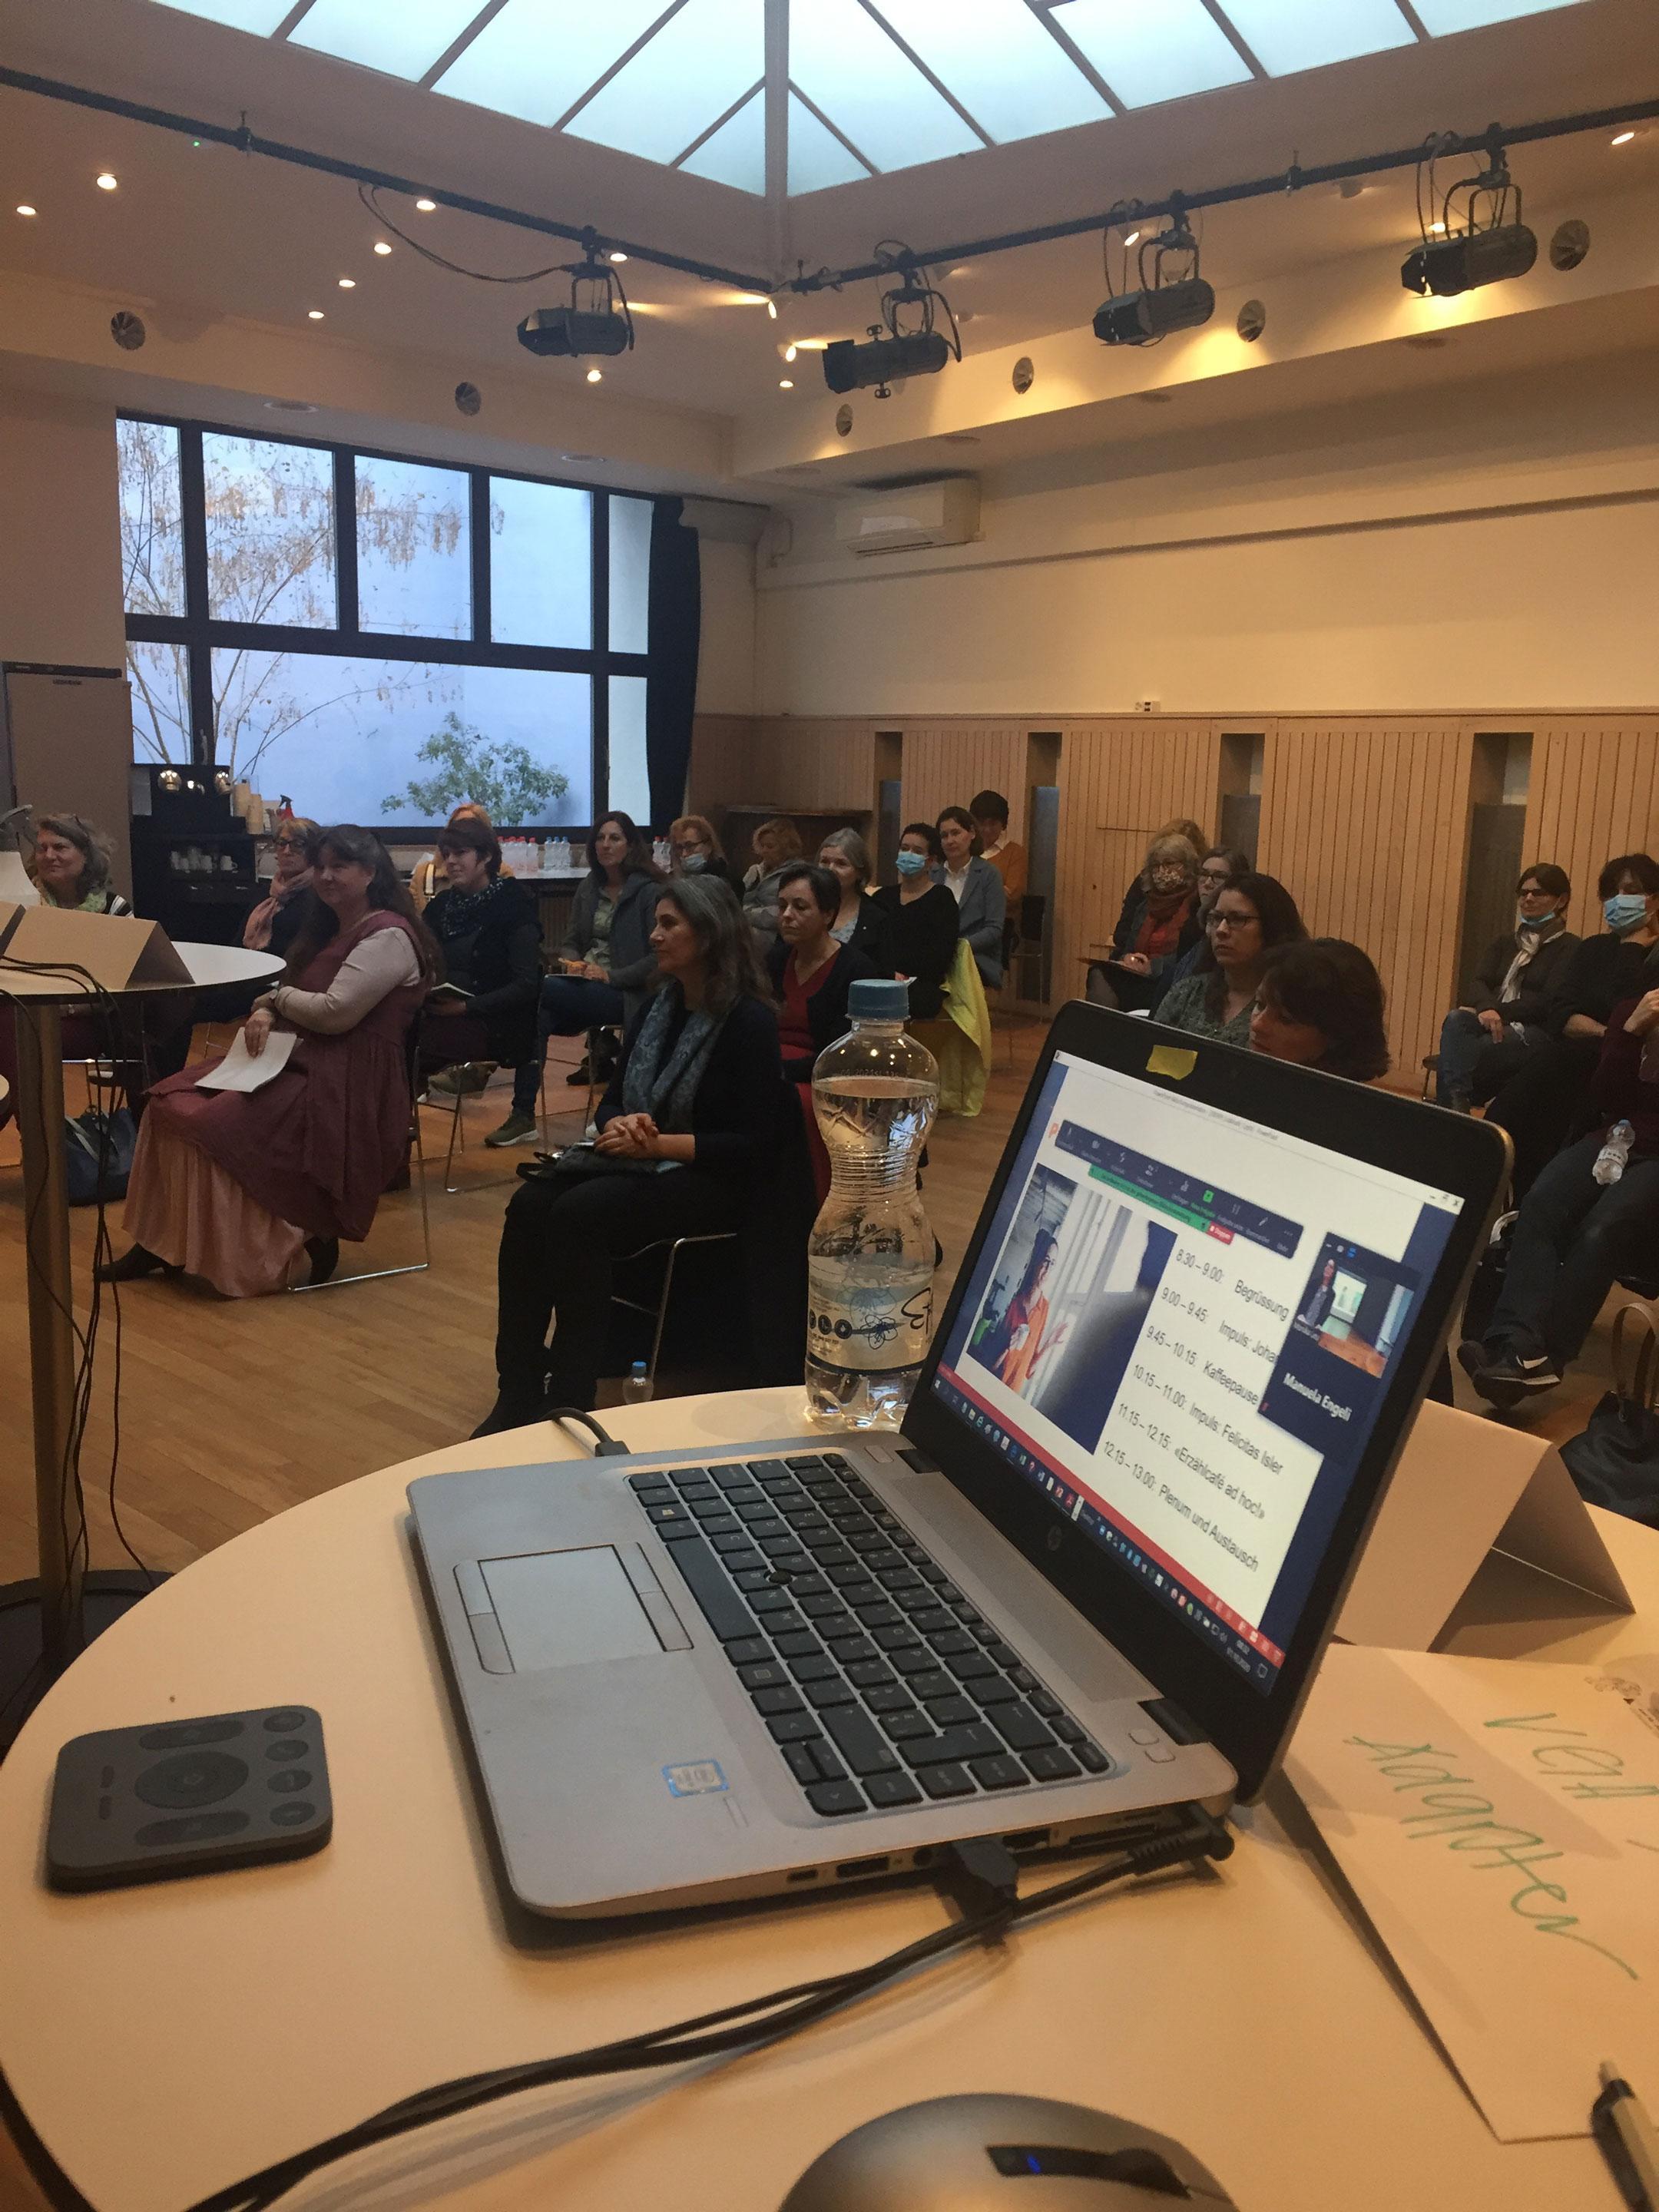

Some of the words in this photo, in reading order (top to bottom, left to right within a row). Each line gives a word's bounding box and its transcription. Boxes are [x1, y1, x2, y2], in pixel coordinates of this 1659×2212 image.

[1175, 1249, 1196, 1267] 8.30
[1202, 1263, 1224, 1283] 9.00:
[1234, 1280, 1290, 1321] Begrüssung
[1161, 1287, 1181, 1306] 9.00
[1187, 1302, 1209, 1323] 9.45:
[1219, 1320, 1251, 1349] Impuls:
[1252, 1340, 1277, 1363] Joha
[1147, 1326, 1166, 1346] 9.45
[1173, 1342, 1197, 1367] 10.15:
[1203, 1360, 1260, 1405] Kaffeepause
[1283, 1373, 1322, 1404] Manuela
[1321, 1395, 1353, 1422] Engeli
[1118, 1402, 1140, 1426] 11.15
[1147, 1424, 1171, 1450] 12.15:
[1225, 1483, 1240, 1499] ad
[1134, 1365, 1156, 1387] 10.15
[1162, 1384, 1187, 1409] 11.00:
[1190, 1402, 1220, 1432] Impuls:
[1221, 1424, 1260, 1461] Felicitas
[1104, 1441, 1125, 1465] 12.15
[1132, 1463, 1157, 1490] 13.00:
[1158, 1484, 1191, 1519] Plenum
[1192, 1512, 1211, 1534] und
[1210, 1525, 1259, 1572] Austausch
